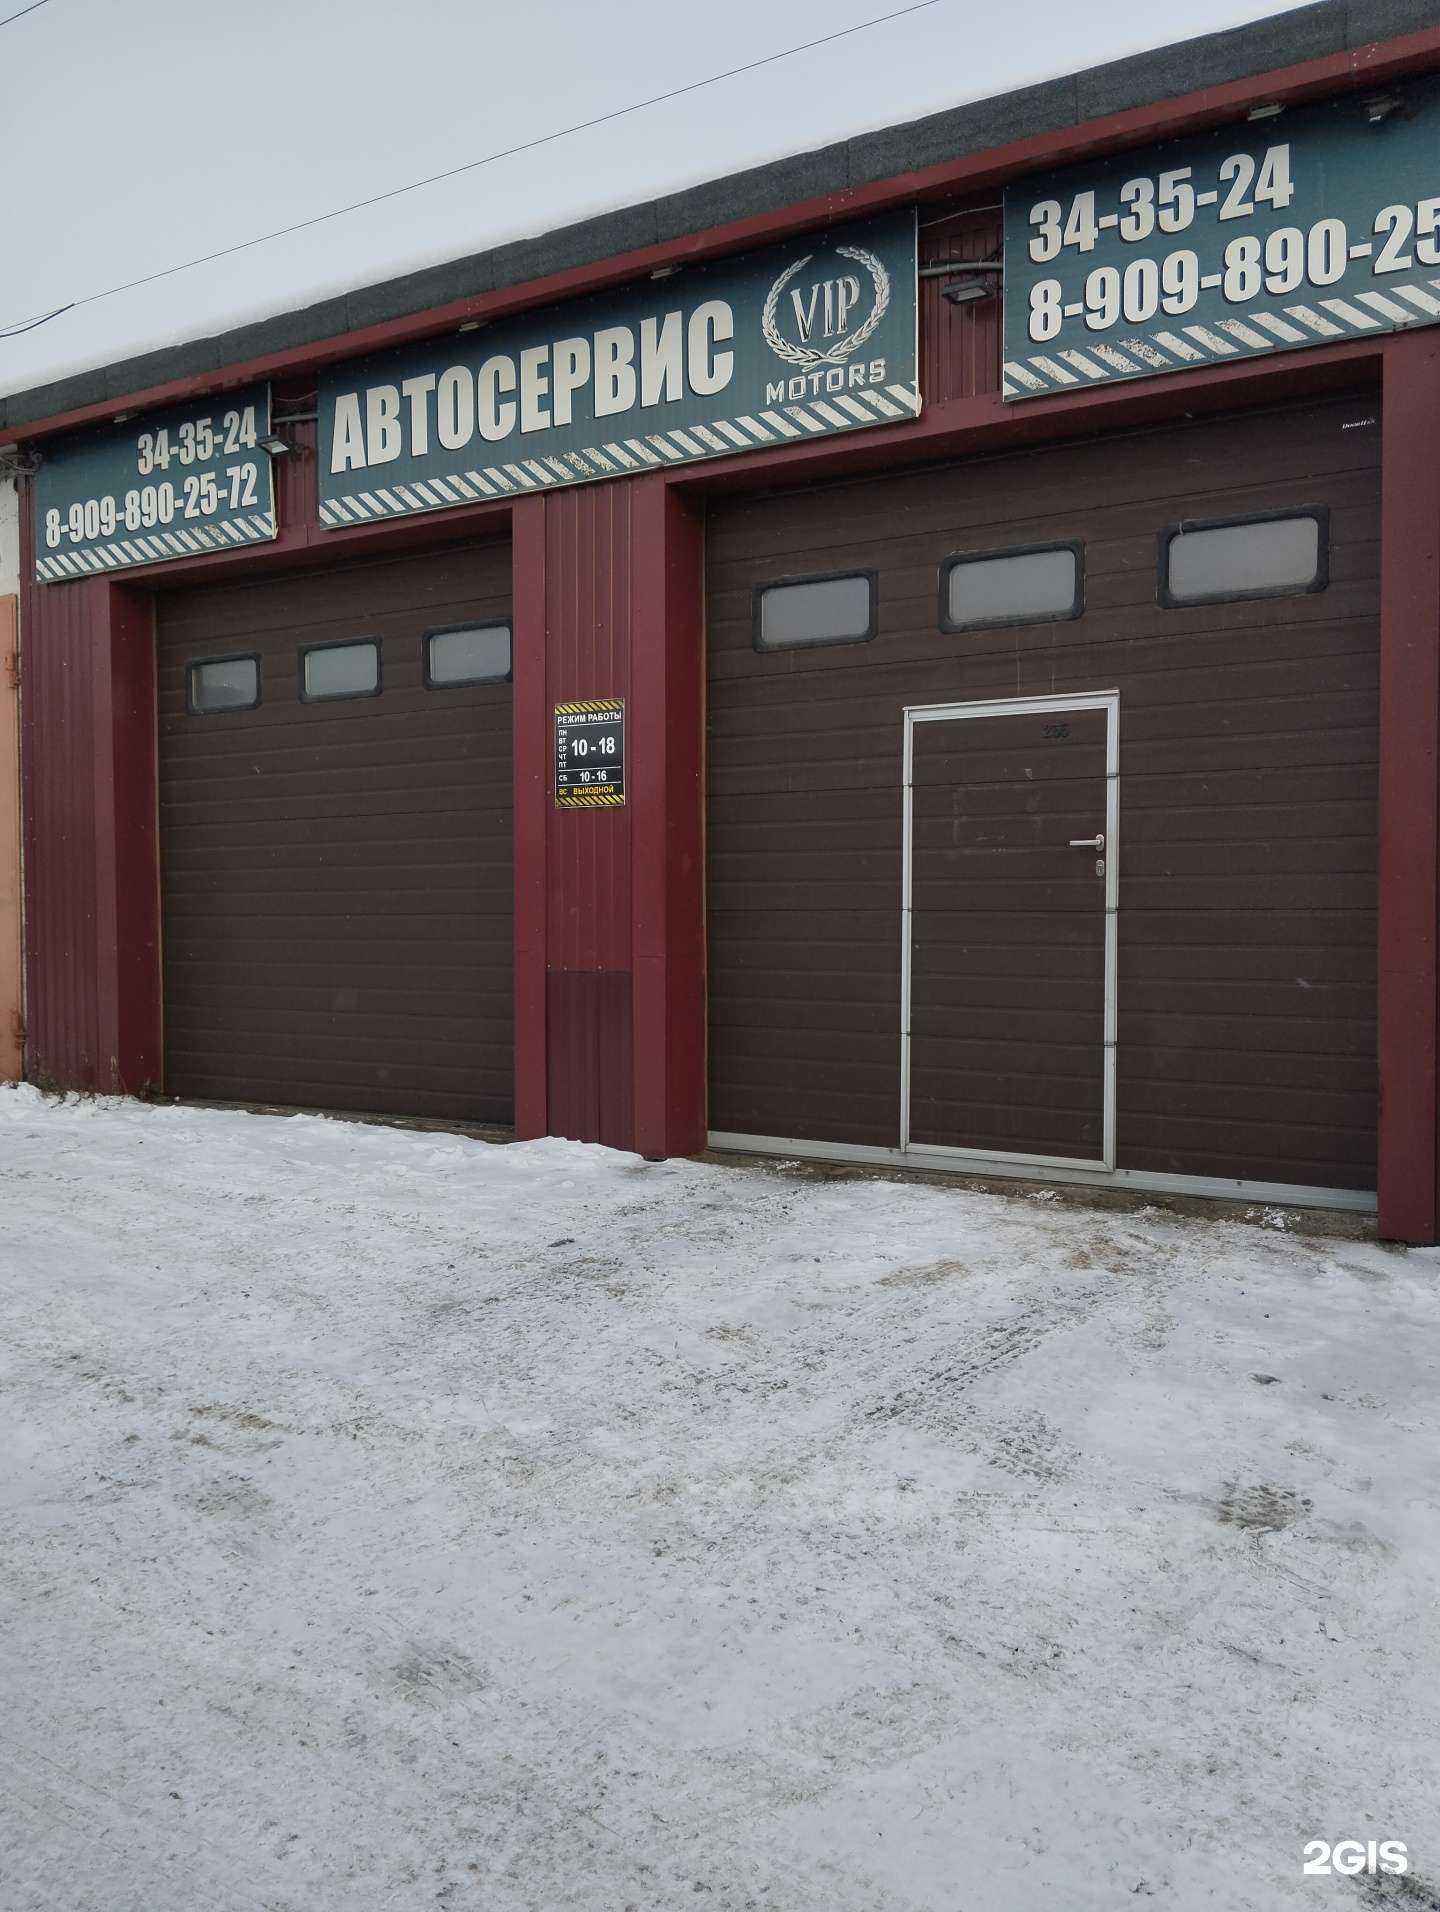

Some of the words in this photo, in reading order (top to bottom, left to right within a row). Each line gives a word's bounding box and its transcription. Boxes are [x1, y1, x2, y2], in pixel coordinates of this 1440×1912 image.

[1029, 144, 1294, 262] 34-35-24
[790, 275, 861, 343] VIP
[330, 300, 734, 474] АВТОСЕРВИС
[766, 359, 886, 405] MOTORS
[137, 406, 257, 475] 34-35-24
[45, 463, 257, 548] 8-909-890-25-72
[558, 715, 586, 724] РЕЖИМ
[588, 712, 622, 722] РАБОТЫ
[573, 785, 614, 795] ВЫХОДНОЙ
